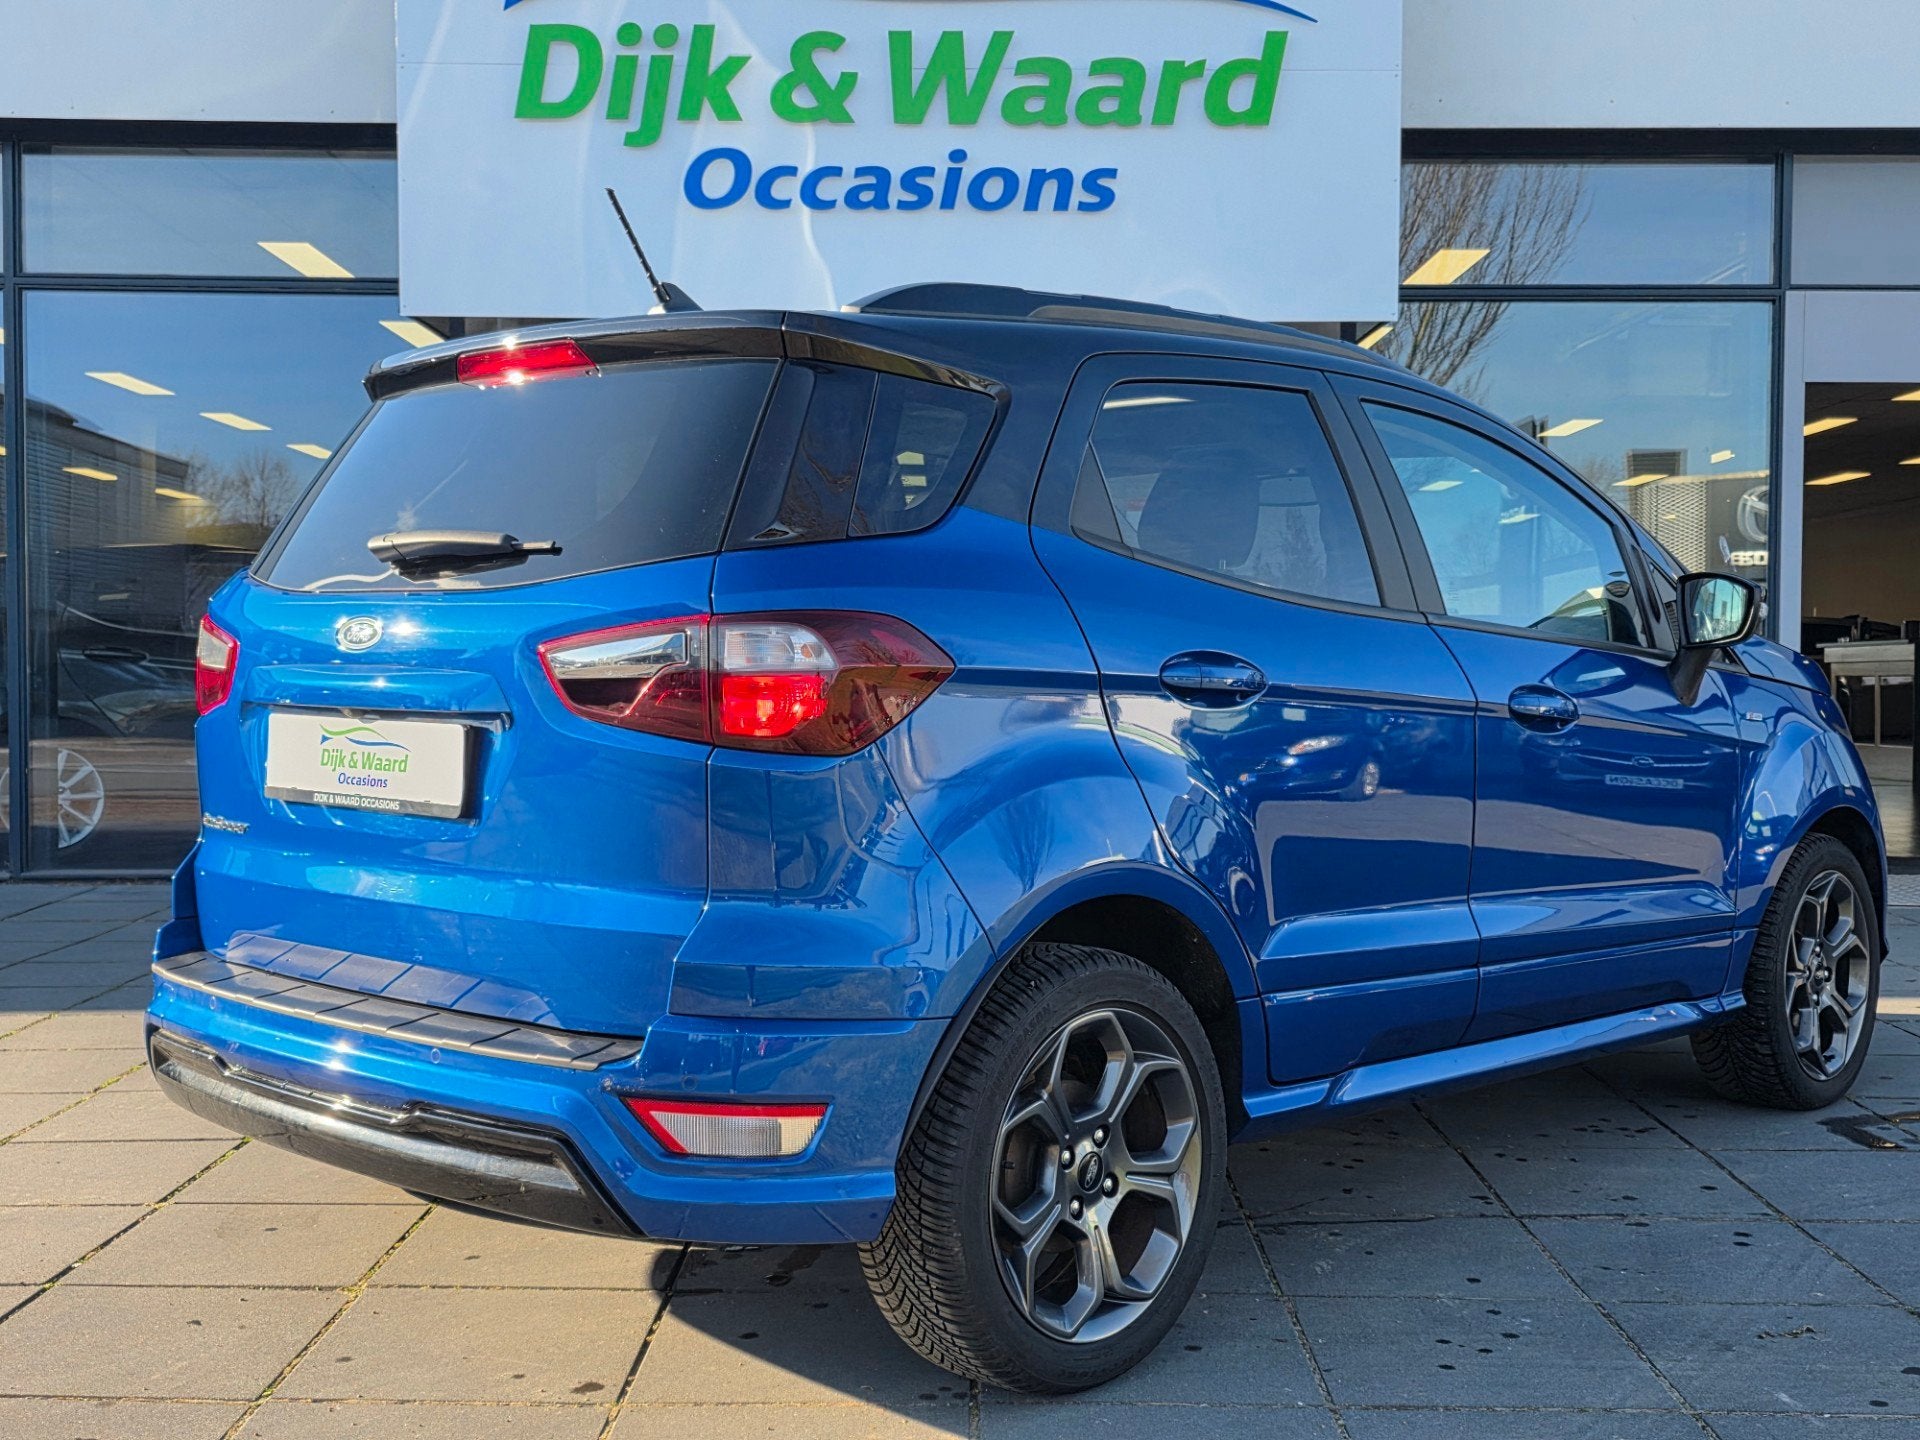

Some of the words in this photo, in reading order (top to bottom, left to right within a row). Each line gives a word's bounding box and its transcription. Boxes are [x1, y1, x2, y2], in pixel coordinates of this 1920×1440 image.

[514, 23, 752, 147] Dijk
[770, 31, 858, 123] &
[888, 31, 1288, 126] Waard
[684, 148, 1118, 211] Occasions
[320, 749, 346, 771] Dijk
[348, 752, 358, 769] &
[361, 752, 408, 772] Waard
[338, 772, 388, 788] Occasions
[313, 792, 329, 803] DIJK
[335, 794, 360, 806] WAARD
[360, 798, 400, 811] OCCASIONS
